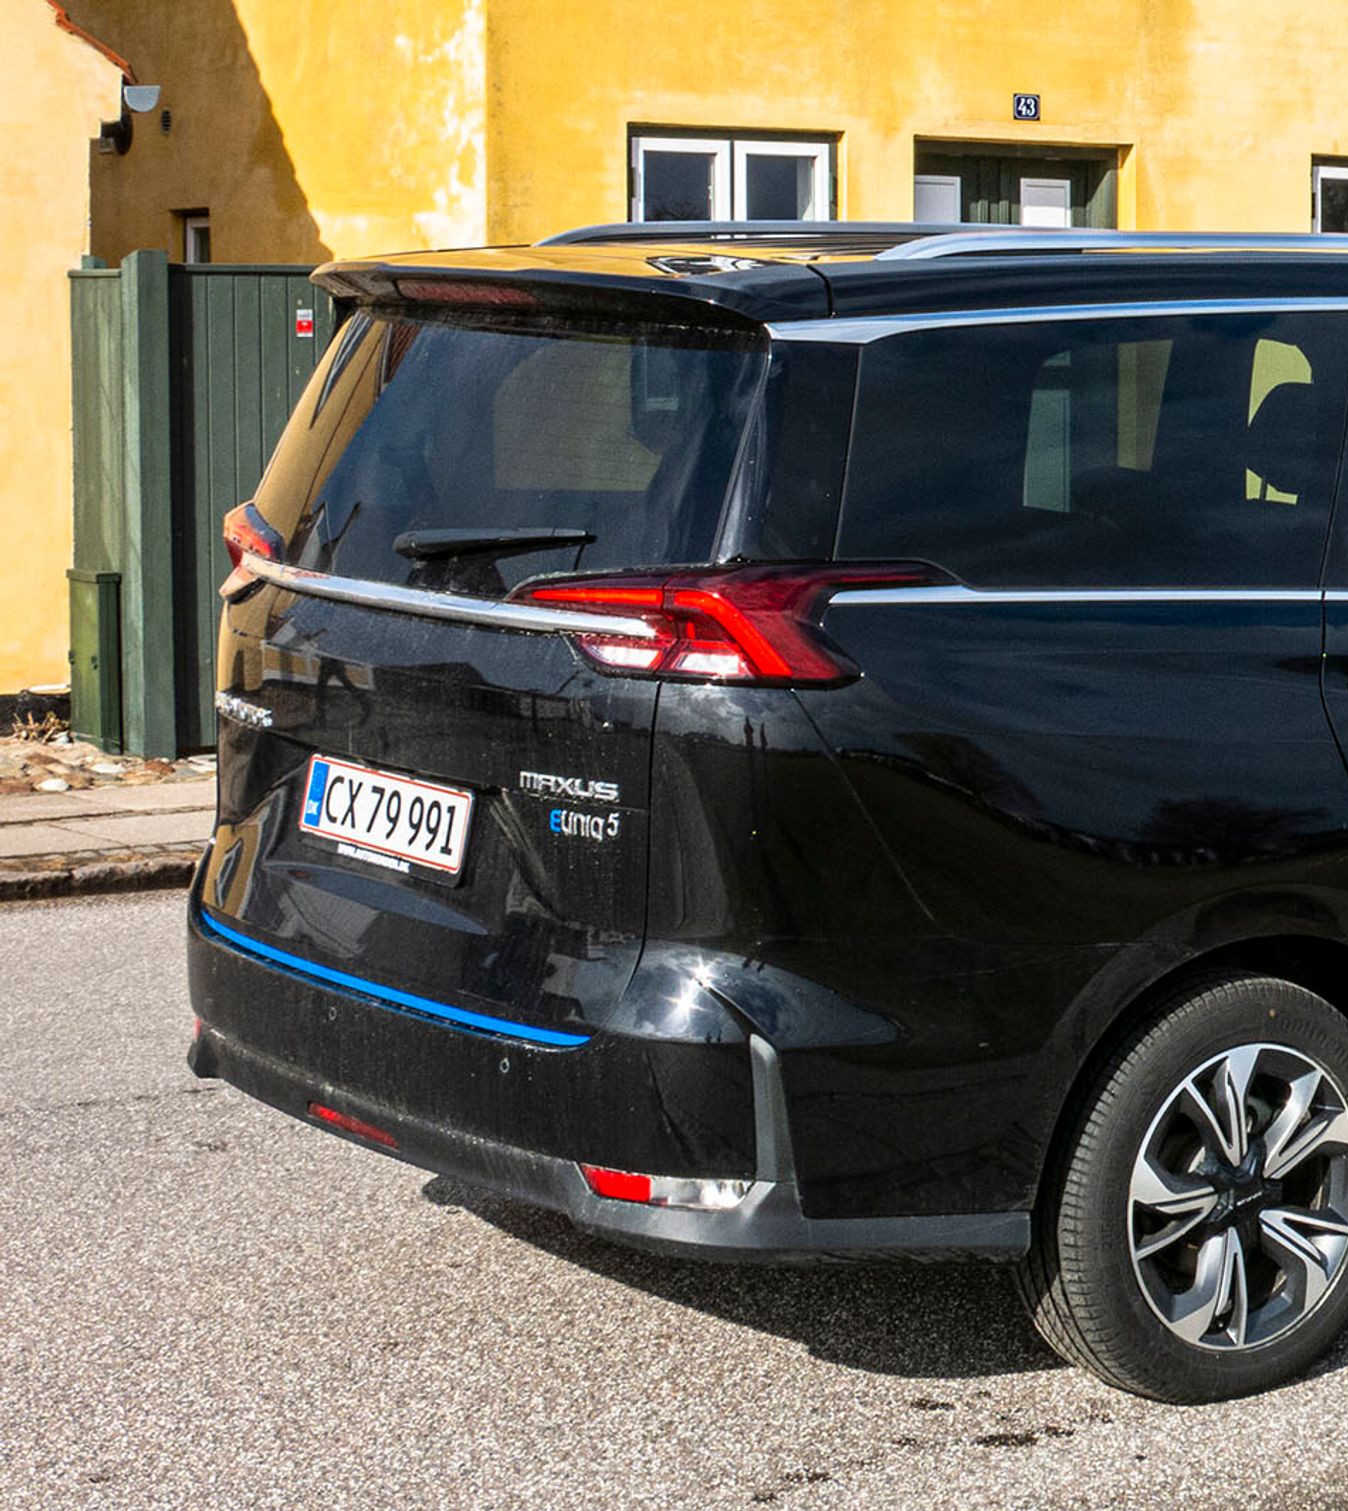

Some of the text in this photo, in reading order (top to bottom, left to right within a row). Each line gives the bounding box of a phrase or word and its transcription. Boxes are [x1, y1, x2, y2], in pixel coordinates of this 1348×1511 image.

[1017, 97, 1036, 117] 43
[519, 770, 620, 801] MAXUS
[325, 775, 456, 856] CX 79 991
[606, 812, 620, 837] 5
